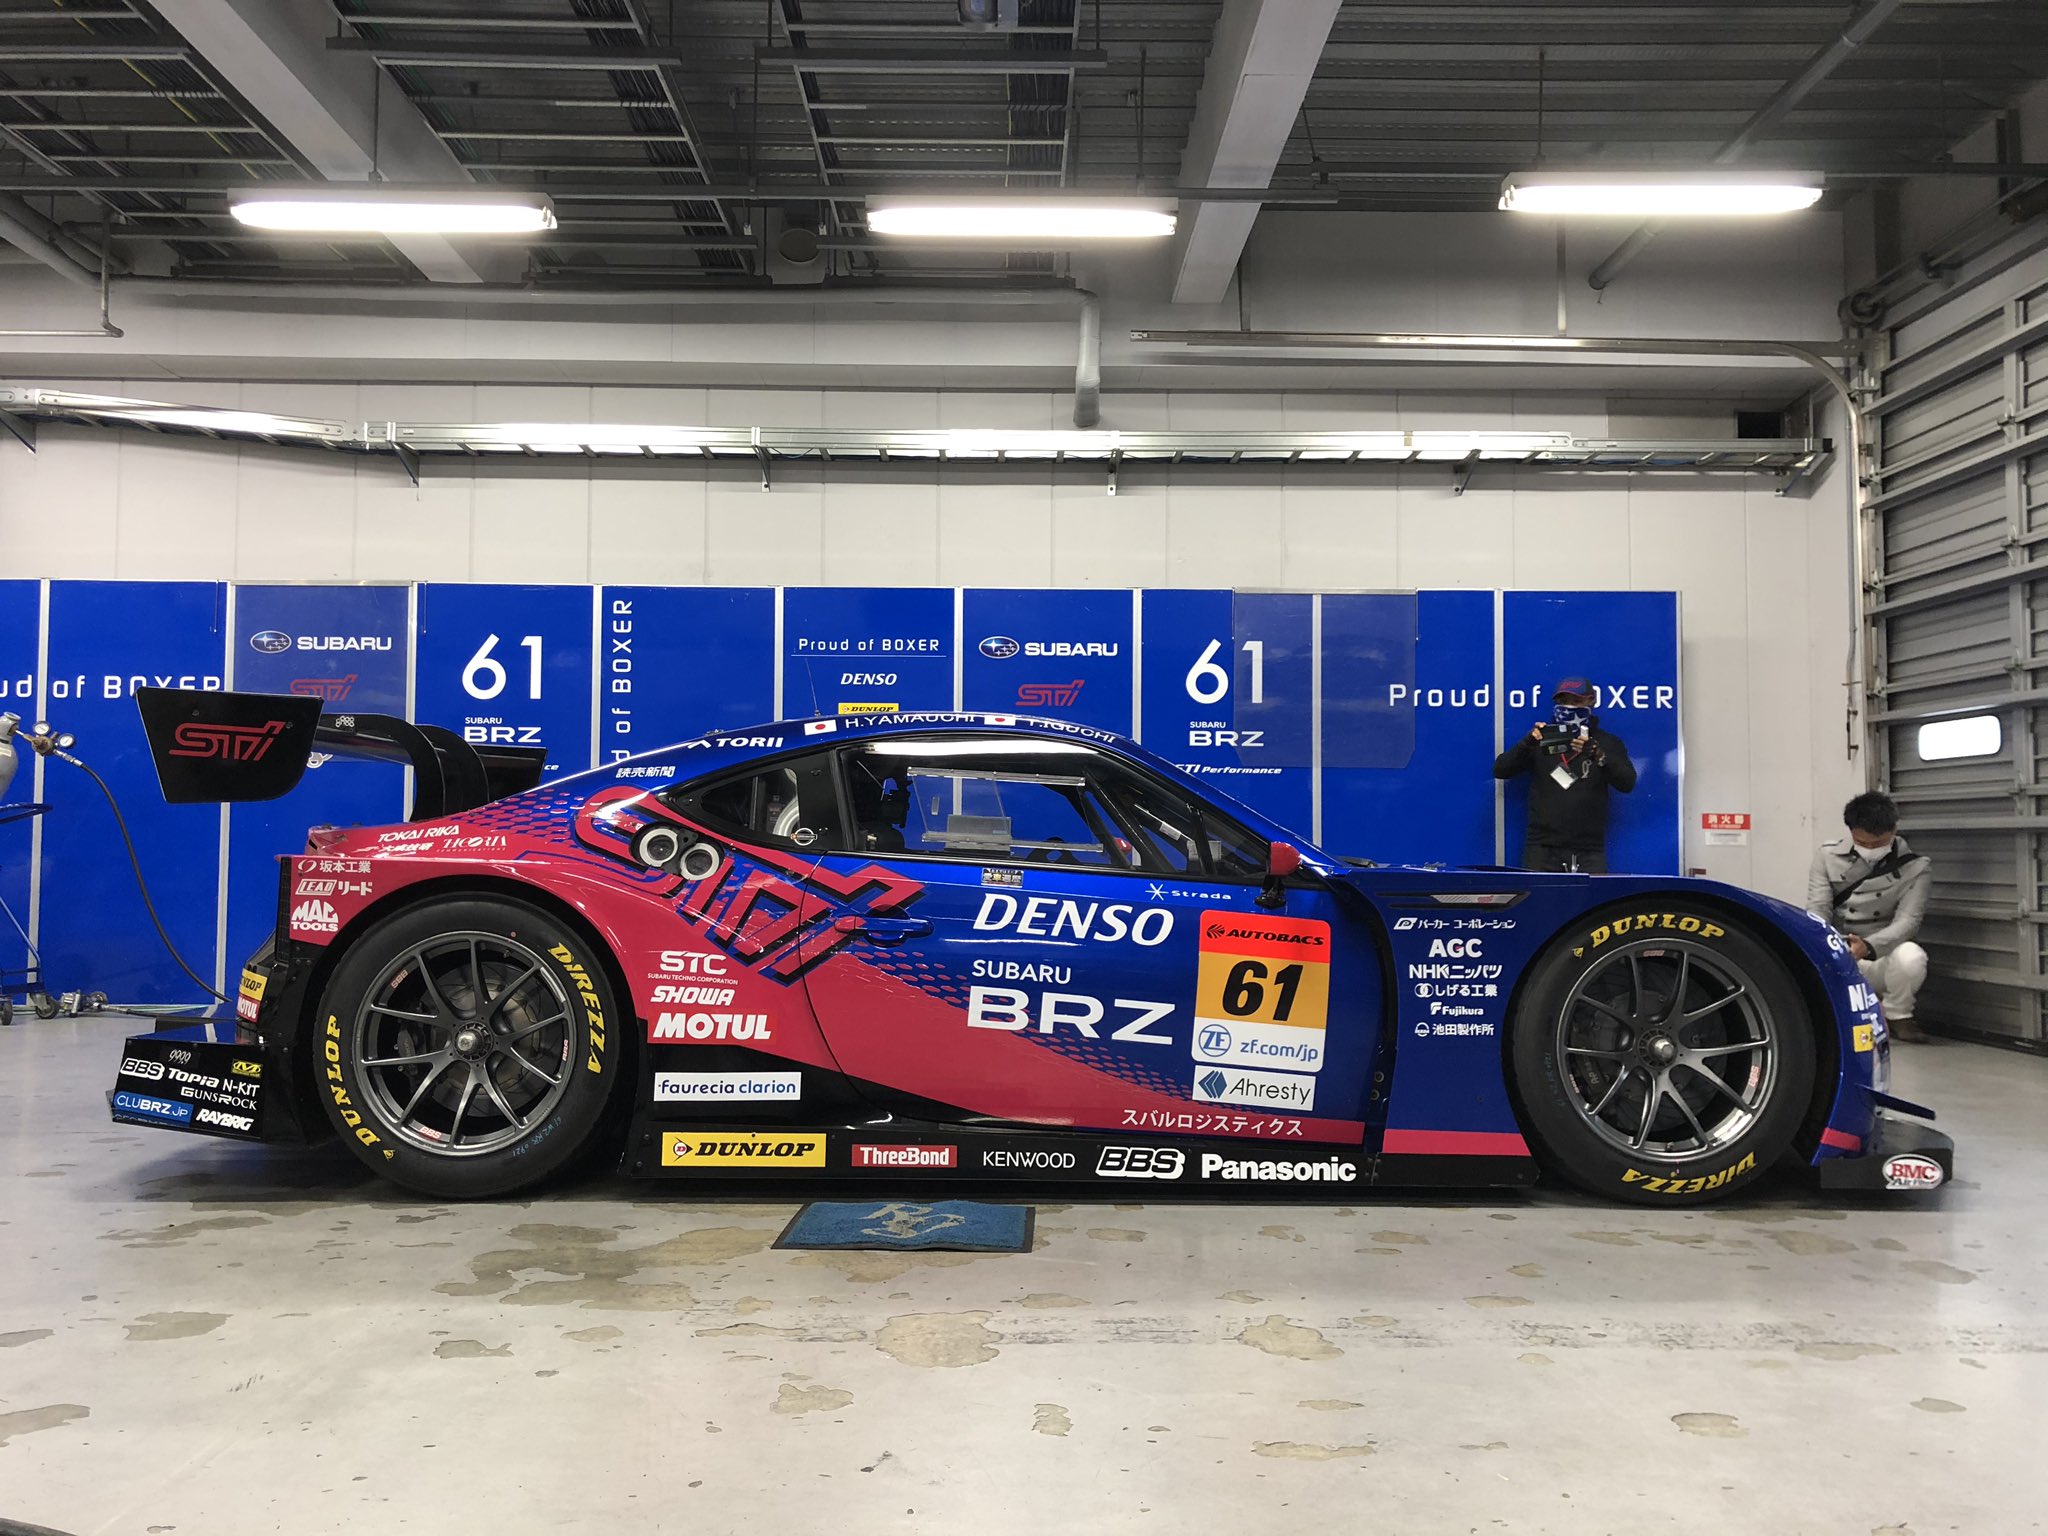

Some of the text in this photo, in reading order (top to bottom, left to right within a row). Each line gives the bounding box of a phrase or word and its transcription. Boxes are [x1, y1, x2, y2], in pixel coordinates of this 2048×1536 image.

[297, 636, 392, 651] SUBARU
[612, 600, 633, 693] BOXER
[798, 637, 940, 652] Proud of BOXER
[1024, 642, 1118, 657] SUBARU
[462, 634, 543, 700] 61
[1185, 638, 1264, 704] 61
[53, 675, 86, 698] of
[840, 673, 897, 686] DENSO
[1390, 684, 1489, 708] Proud
[1510, 684, 1541, 708] of
[465, 717, 502, 725] SUBARU
[1190, 721, 1226, 729] SUBARU
[464, 726, 542, 743] BRZ
[716, 736, 783, 748] TORII
[1189, 730, 1264, 747] BRZ
[1202, 766, 1282, 774] Performance
[378, 825, 460, 843] TOKAI RIKA
[320, 861, 371, 873] 坂本工業
[299, 881, 334, 893] LEAD
[338, 881, 373, 896] リード
[1172, 889, 1232, 900] Strada
[291, 900, 338, 923] MAC
[972, 893, 1174, 946] DENSO
[291, 922, 338, 932] TOOLS
[1227, 927, 1324, 946] AUTOBACS
[1590, 913, 1725, 948] DUNLOP
[1428, 939, 1483, 958] AGC
[660, 951, 727, 975] STC
[972, 959, 1071, 985] SUBARU
[672, 974, 696, 982] TECHNO
[696, 976, 738, 985] CORPORATION
[650, 985, 735, 1006] SHOWA
[1221, 960, 1304, 1022] 61
[1435, 984, 1498, 997] しげる工業
[547, 942, 607, 1074] DIREZZA
[966, 985, 1176, 1045] BRZ
[1442, 1006, 1484, 1016] Fujikura
[652, 1012, 772, 1040] MOTUL
[1432, 1023, 1495, 1036] 池田製作所
[1240, 1040, 1319, 1063] zf.com/jp
[118, 1058, 165, 1080] BBS
[222, 1078, 261, 1097] N-KIT
[325, 1015, 381, 1147] DUNLOP
[661, 1079, 796, 1094] faurecia clarion
[1229, 1078, 1311, 1105] Ahresty
[196, 1108, 254, 1131] RAYBRIG
[1121, 1109, 1304, 1136] スバルロジスティクス
[419, 1126, 442, 1139] BBS
[695, 1141, 815, 1157] DUNLOP
[860, 1146, 949, 1166] ThreeBond
[983, 1151, 1075, 1168] KENWOOD
[1098, 1147, 1184, 1179] BBS
[1202, 1153, 1357, 1182] Panasonic
[1621, 1152, 1758, 1194] DIREZZA
[1892, 1163, 1936, 1180] BMC
